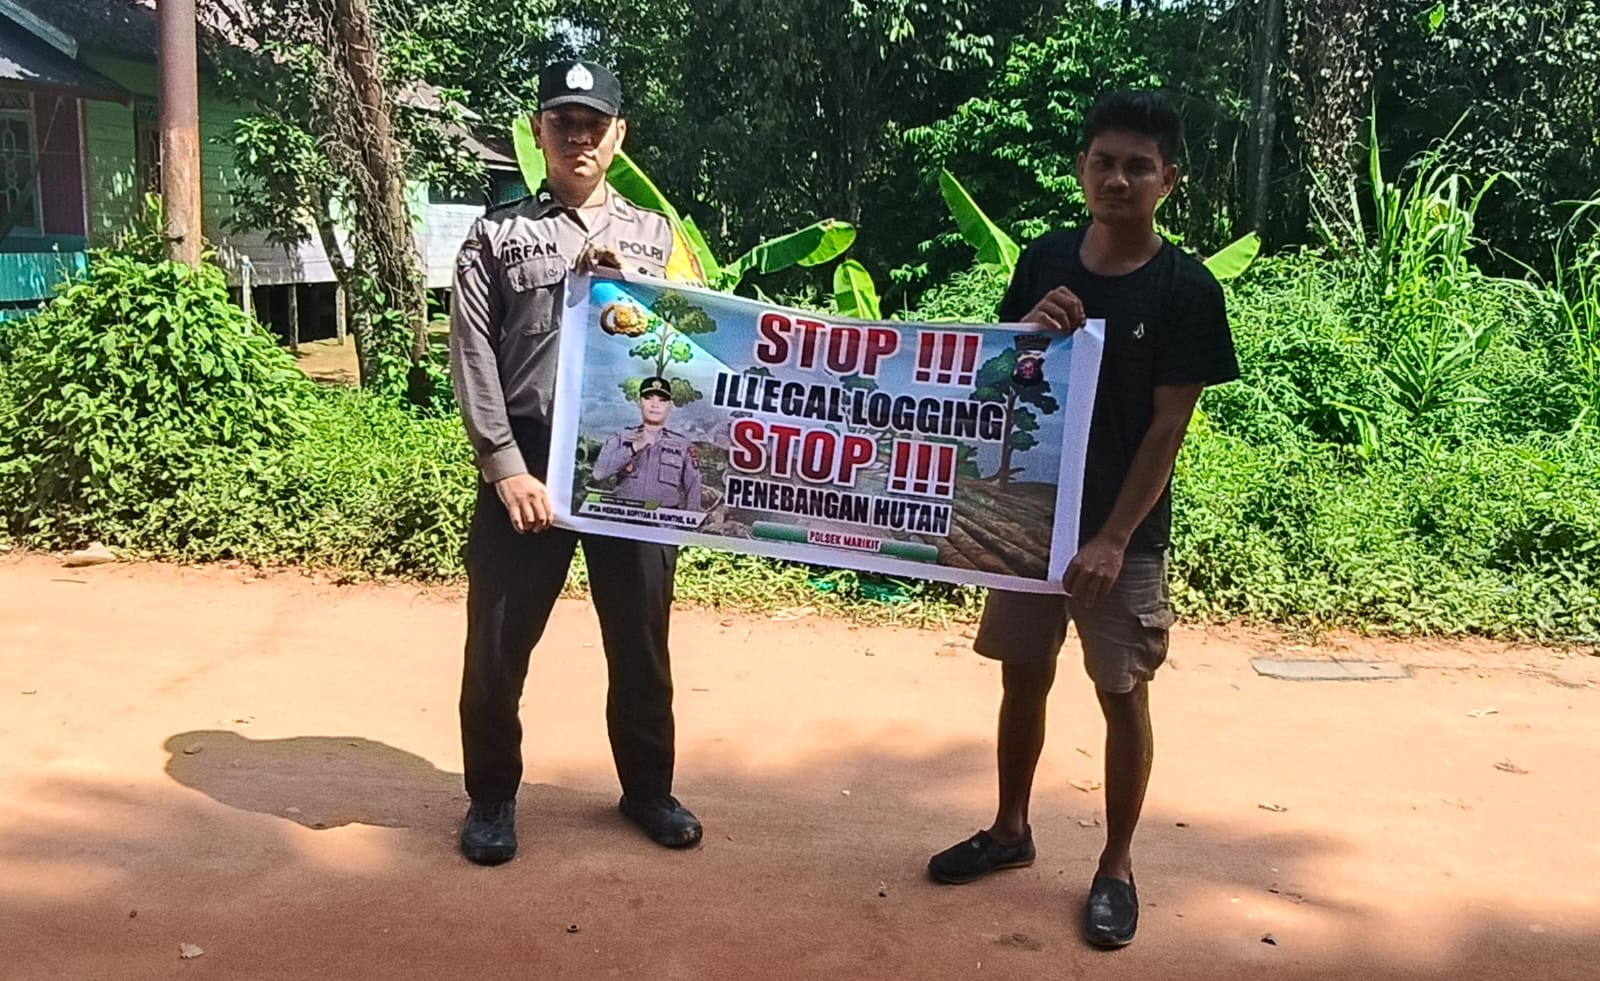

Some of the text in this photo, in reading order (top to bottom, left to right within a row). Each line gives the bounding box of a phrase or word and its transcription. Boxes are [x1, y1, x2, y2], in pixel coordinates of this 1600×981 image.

[504, 241, 558, 263] IRFAN
[619, 240, 664, 261] POLRI
[756, 312, 980, 387] STOP !!!
[713, 372, 1006, 441] ILLEGAL LOGGING
[732, 420, 955, 496] STOP !!!
[726, 477, 951, 535] PENEBANGAN HUTAN
[810, 531, 880, 550] POLSEK MARIKIT
